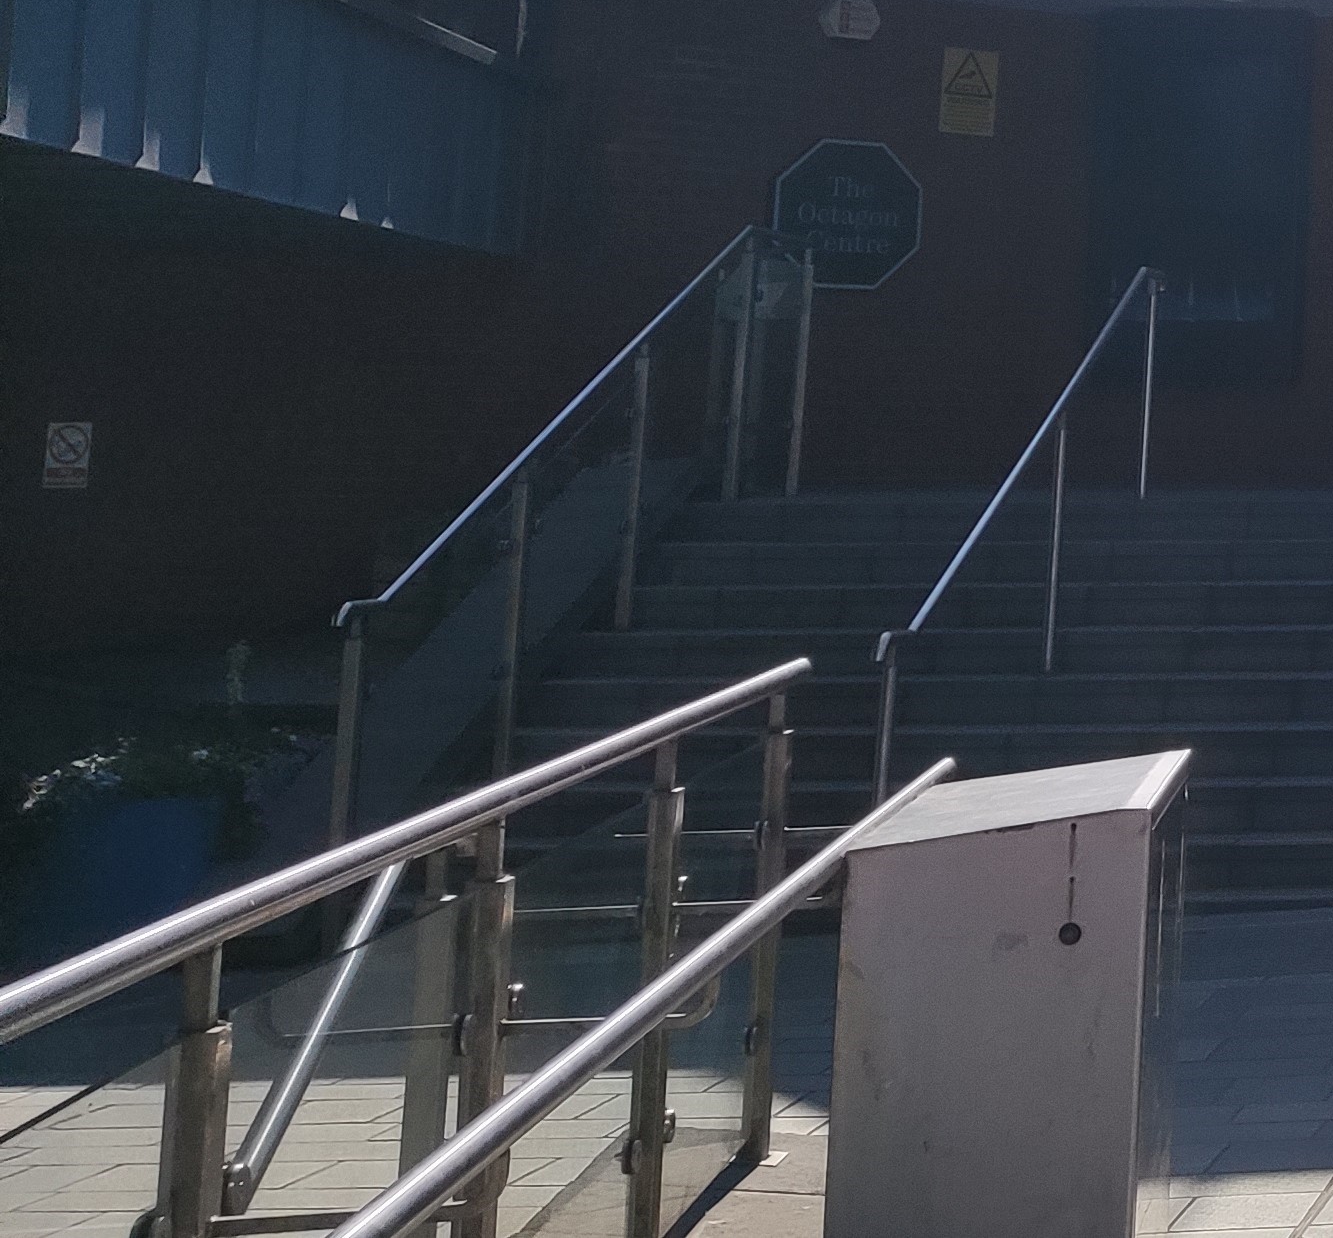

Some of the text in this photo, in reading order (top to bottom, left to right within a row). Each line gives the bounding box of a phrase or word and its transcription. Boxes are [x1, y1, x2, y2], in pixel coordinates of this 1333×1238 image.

[954, 82, 983, 94] CCTV
[827, 175, 875, 198] The
[798, 201, 899, 231] Octagon
